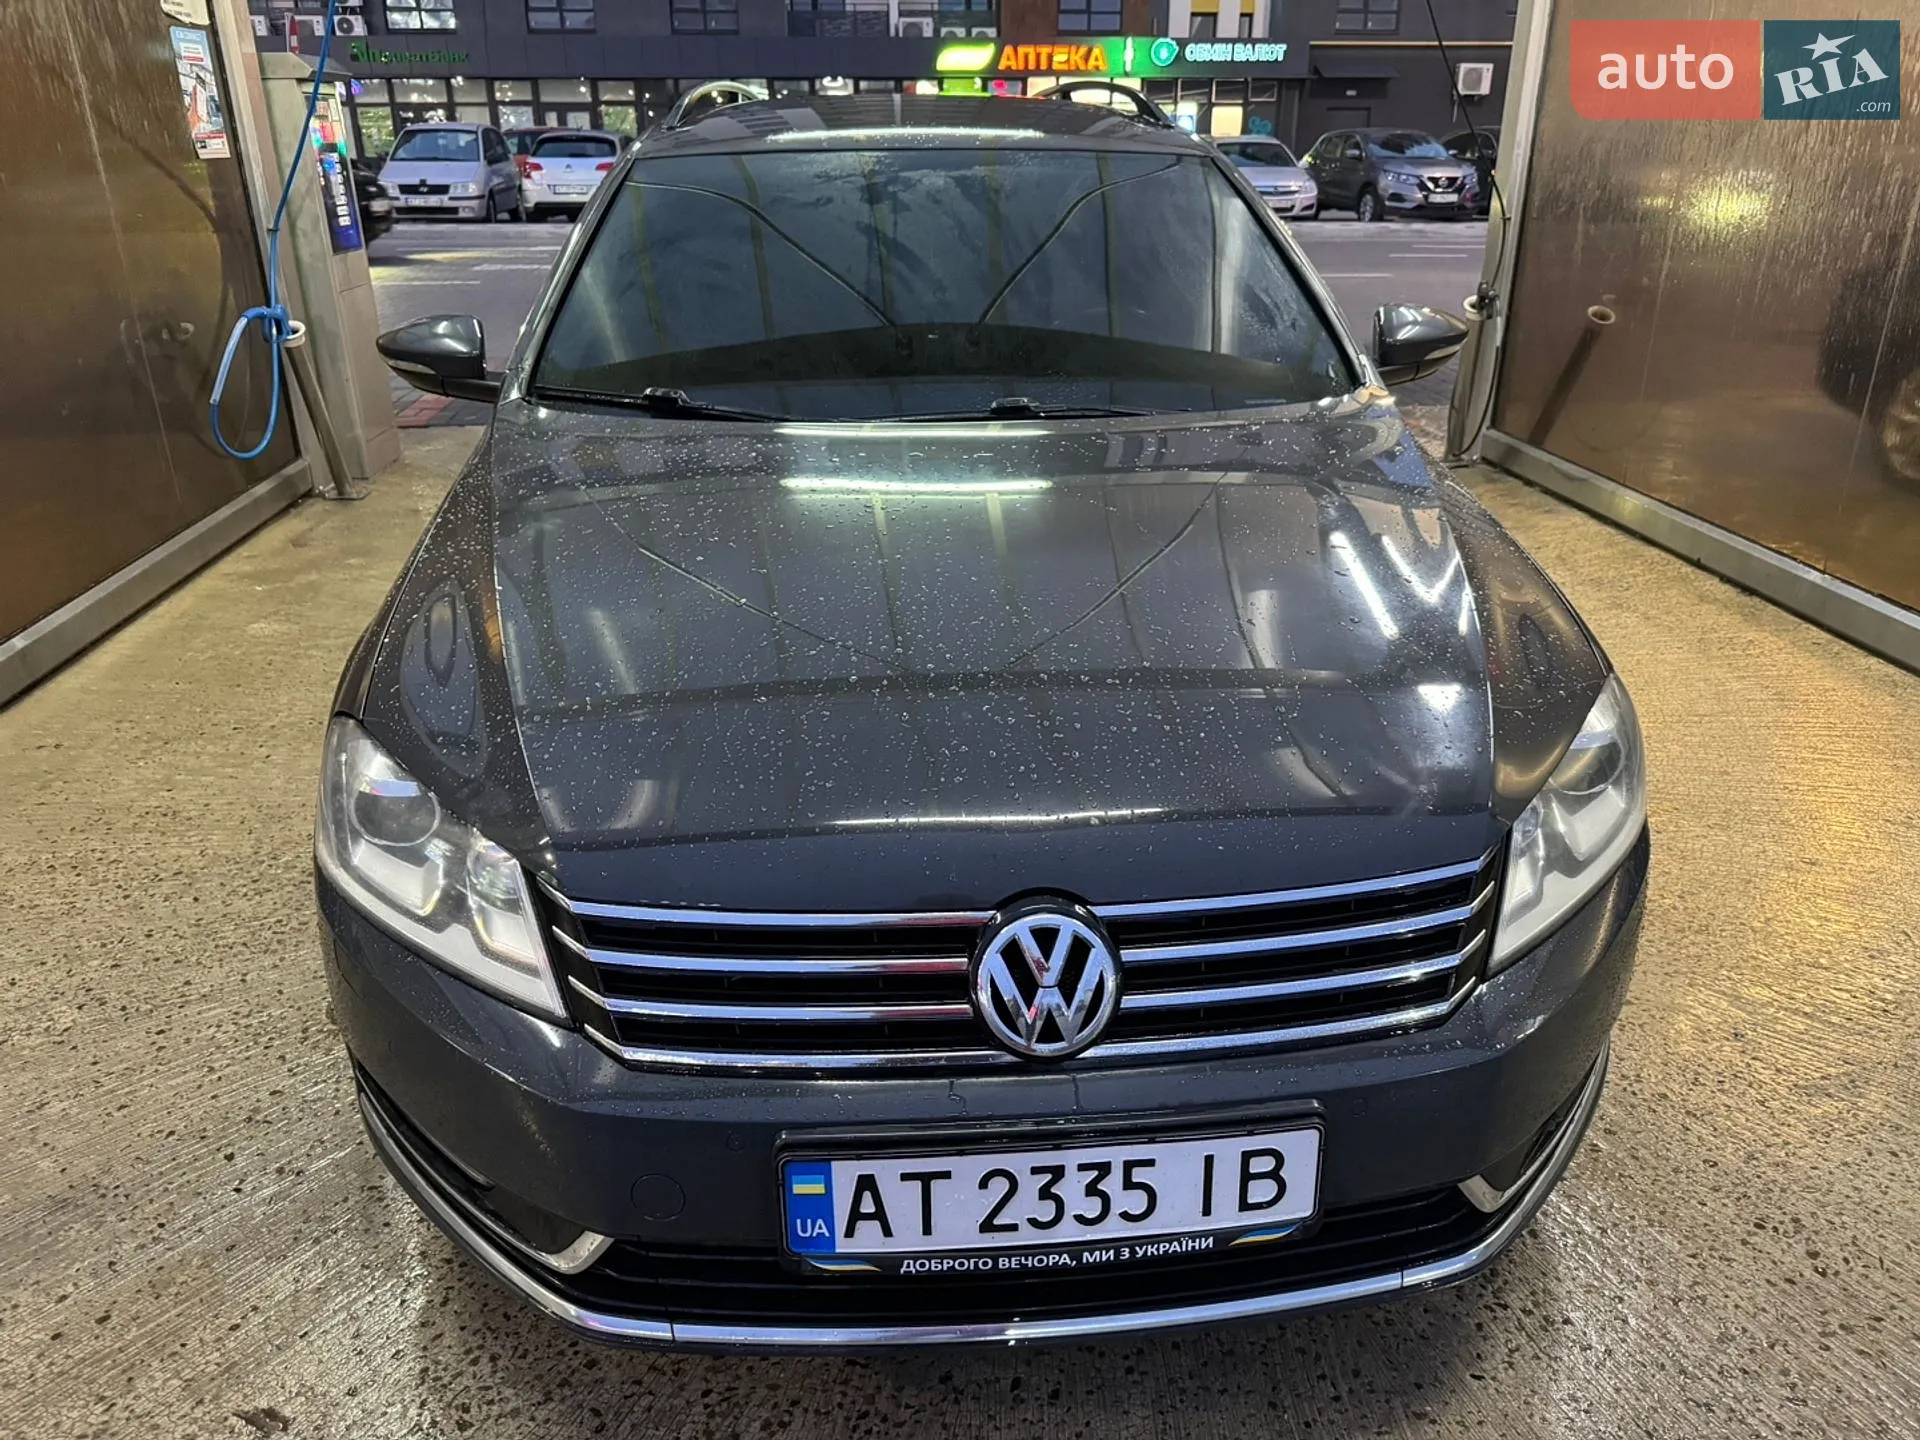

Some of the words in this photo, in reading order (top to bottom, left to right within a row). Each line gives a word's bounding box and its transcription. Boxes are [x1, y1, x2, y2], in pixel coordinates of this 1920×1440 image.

[999, 44, 1107, 71] АПТЕКА
[843, 1170, 952, 1239] AT
[978, 1158, 1157, 1233] 2335
[1201, 1147, 1288, 1217] IB
[797, 1218, 829, 1238] UA
[900, 1257, 993, 1274] ДОБРОГО
[998, 1252, 1077, 1270] ВЕЧОРА,
[1082, 1249, 1115, 1264] МИ
[1119, 1247, 1130, 1260] З
[1135, 1236, 1214, 1257] УКРАЇНИ
